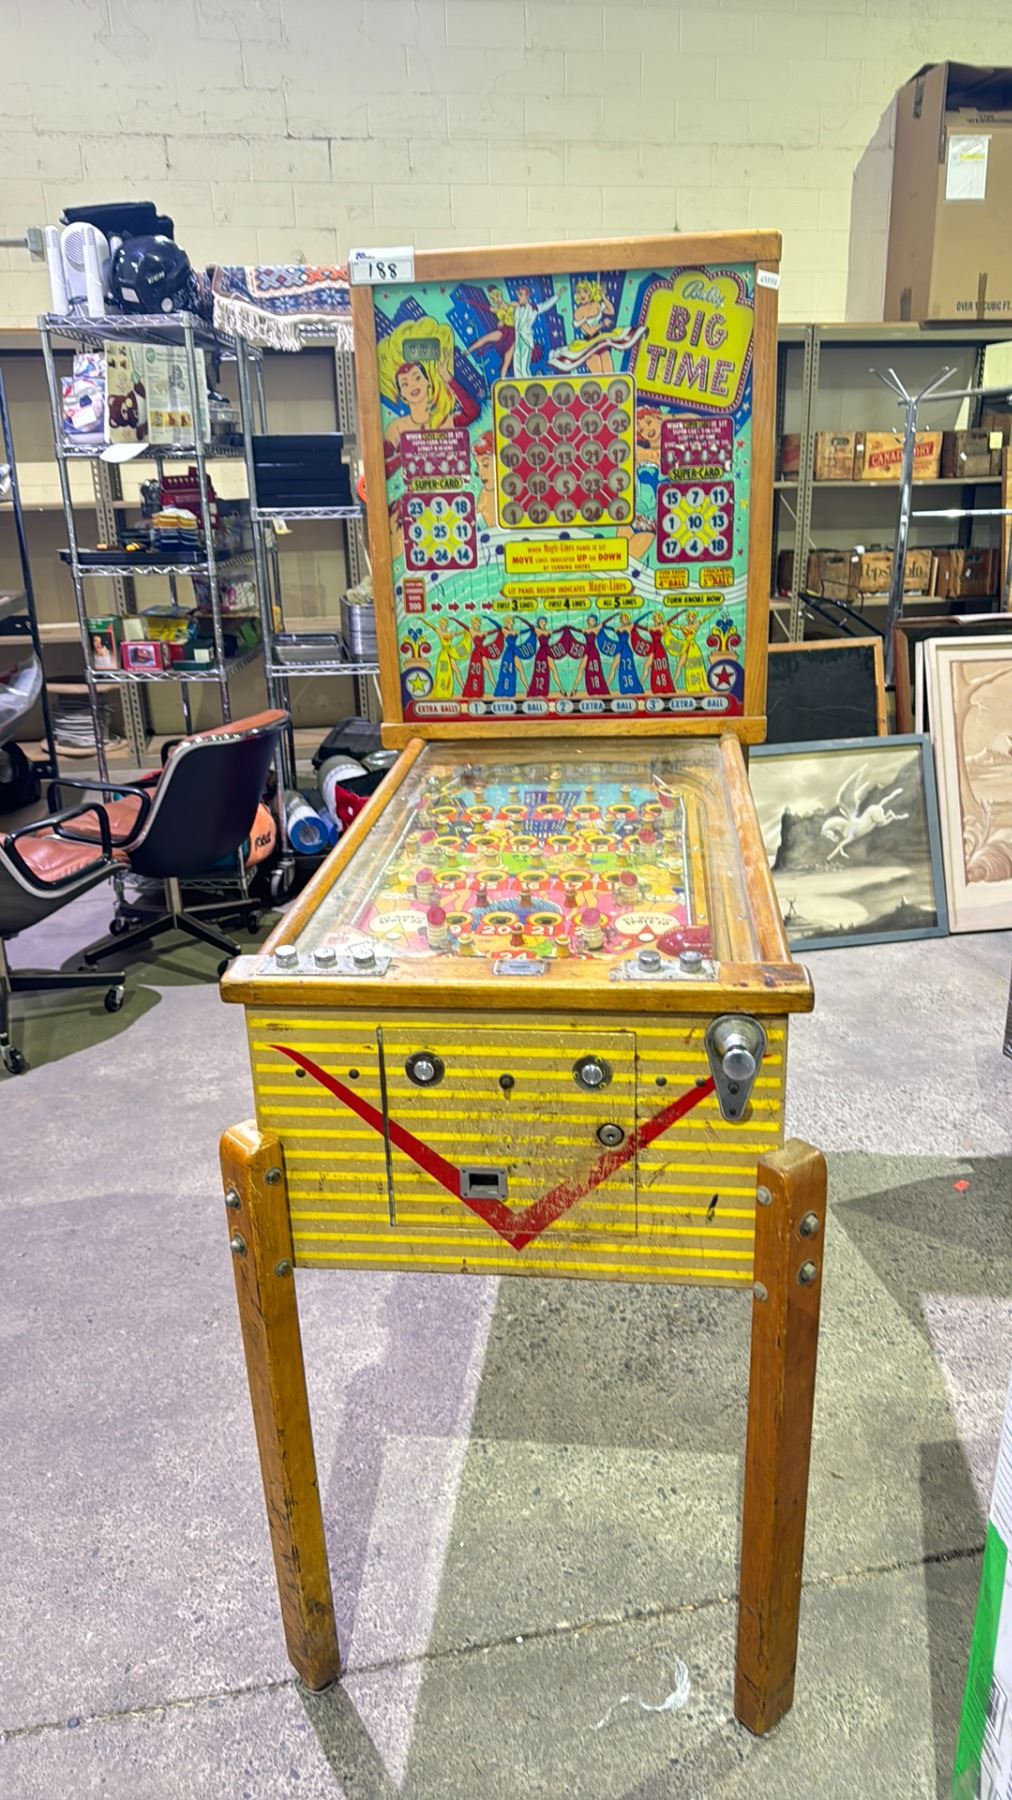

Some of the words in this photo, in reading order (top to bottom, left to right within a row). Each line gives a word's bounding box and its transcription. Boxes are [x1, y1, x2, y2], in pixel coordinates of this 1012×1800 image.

[369, 261, 398, 280] 188
[682, 280, 724, 309] Bally
[666, 304, 728, 350] BIG
[646, 343, 735, 397] TIME
[504, 394, 516, 405] 11
[583, 391, 599, 404] 20
[614, 390, 624, 403] 8
[505, 425, 515, 439] 9
[531, 422, 541, 437] 4
[557, 425, 571, 437] 16
[613, 420, 628, 434] 25
[505, 453, 519, 466] 10
[531, 451, 545, 464] 19
[558, 451, 572, 463] 13
[585, 450, 599, 463] 21
[613, 449, 627, 462] 17
[508, 481, 517, 494] 2
[531, 480, 546, 493] 18
[562, 480, 570, 494] 5
[585, 480, 600, 493] 23
[616, 478, 624, 492] 3
[667, 492, 678, 505] 15
[692, 490, 700, 503] 7
[713, 489, 724, 502] 11
[410, 502, 423, 514] 23
[436, 501, 443, 514] 3
[455, 500, 468, 513] 18
[510, 509, 517, 522] 1
[532, 509, 547, 522] 22
[561, 509, 573, 521] 15
[615, 507, 624, 520] 6
[669, 517, 674, 529] 1
[689, 516, 702, 528] 10
[712, 514, 724, 527] 13
[414, 526, 422, 538] 9
[434, 525, 447, 538] 25
[456, 525, 468, 537] 11
[665, 541, 677, 554] 17
[690, 540, 698, 552] 4
[712, 539, 724, 552] 18
[413, 550, 425, 562] 12
[435, 550, 448, 562] 24
[456, 549, 469, 562] 14
[512, 556, 533, 564] MOVE
[577, 554, 587, 562] UP
[598, 553, 621, 561] DOWN
[518, 587, 534, 595] PANEL
[558, 585, 585, 593] INDICATES
[512, 600, 518, 611] 3
[549, 600, 561, 608] FIRST
[564, 598, 570, 610] 4
[615, 597, 621, 608] 5
[520, 644, 534, 657] 100
[551, 645, 565, 658] 100
[570, 643, 585, 656] 150
[602, 642, 616, 656] 150
[470, 662, 481, 674] 20
[503, 662, 513, 673] 24
[536, 661, 546, 673] 32
[589, 660, 599, 672] 48
[622, 658, 632, 670] 72
[654, 659, 667, 670] 100
[536, 678, 545, 689] 12
[590, 676, 600, 688] 18
[623, 675, 633, 687] 36
[418, 703, 437, 713] EXTRA
[440, 702, 459, 712] BALLS
[493, 703, 514, 712] EXTRA
[527, 702, 543, 711] BALL
[582, 701, 603, 711] EXTRA
[617, 700, 632, 710] BALL
[672, 699, 694, 709] EXTRA
[707, 698, 724, 707] BALL
[513, 844, 530, 852] 10
[553, 844, 567, 853] 11
[522, 881, 540, 890] 16
[481, 925, 511, 935] 20
[531, 926, 554, 936] 21
[500, 952, 527, 961] 24
